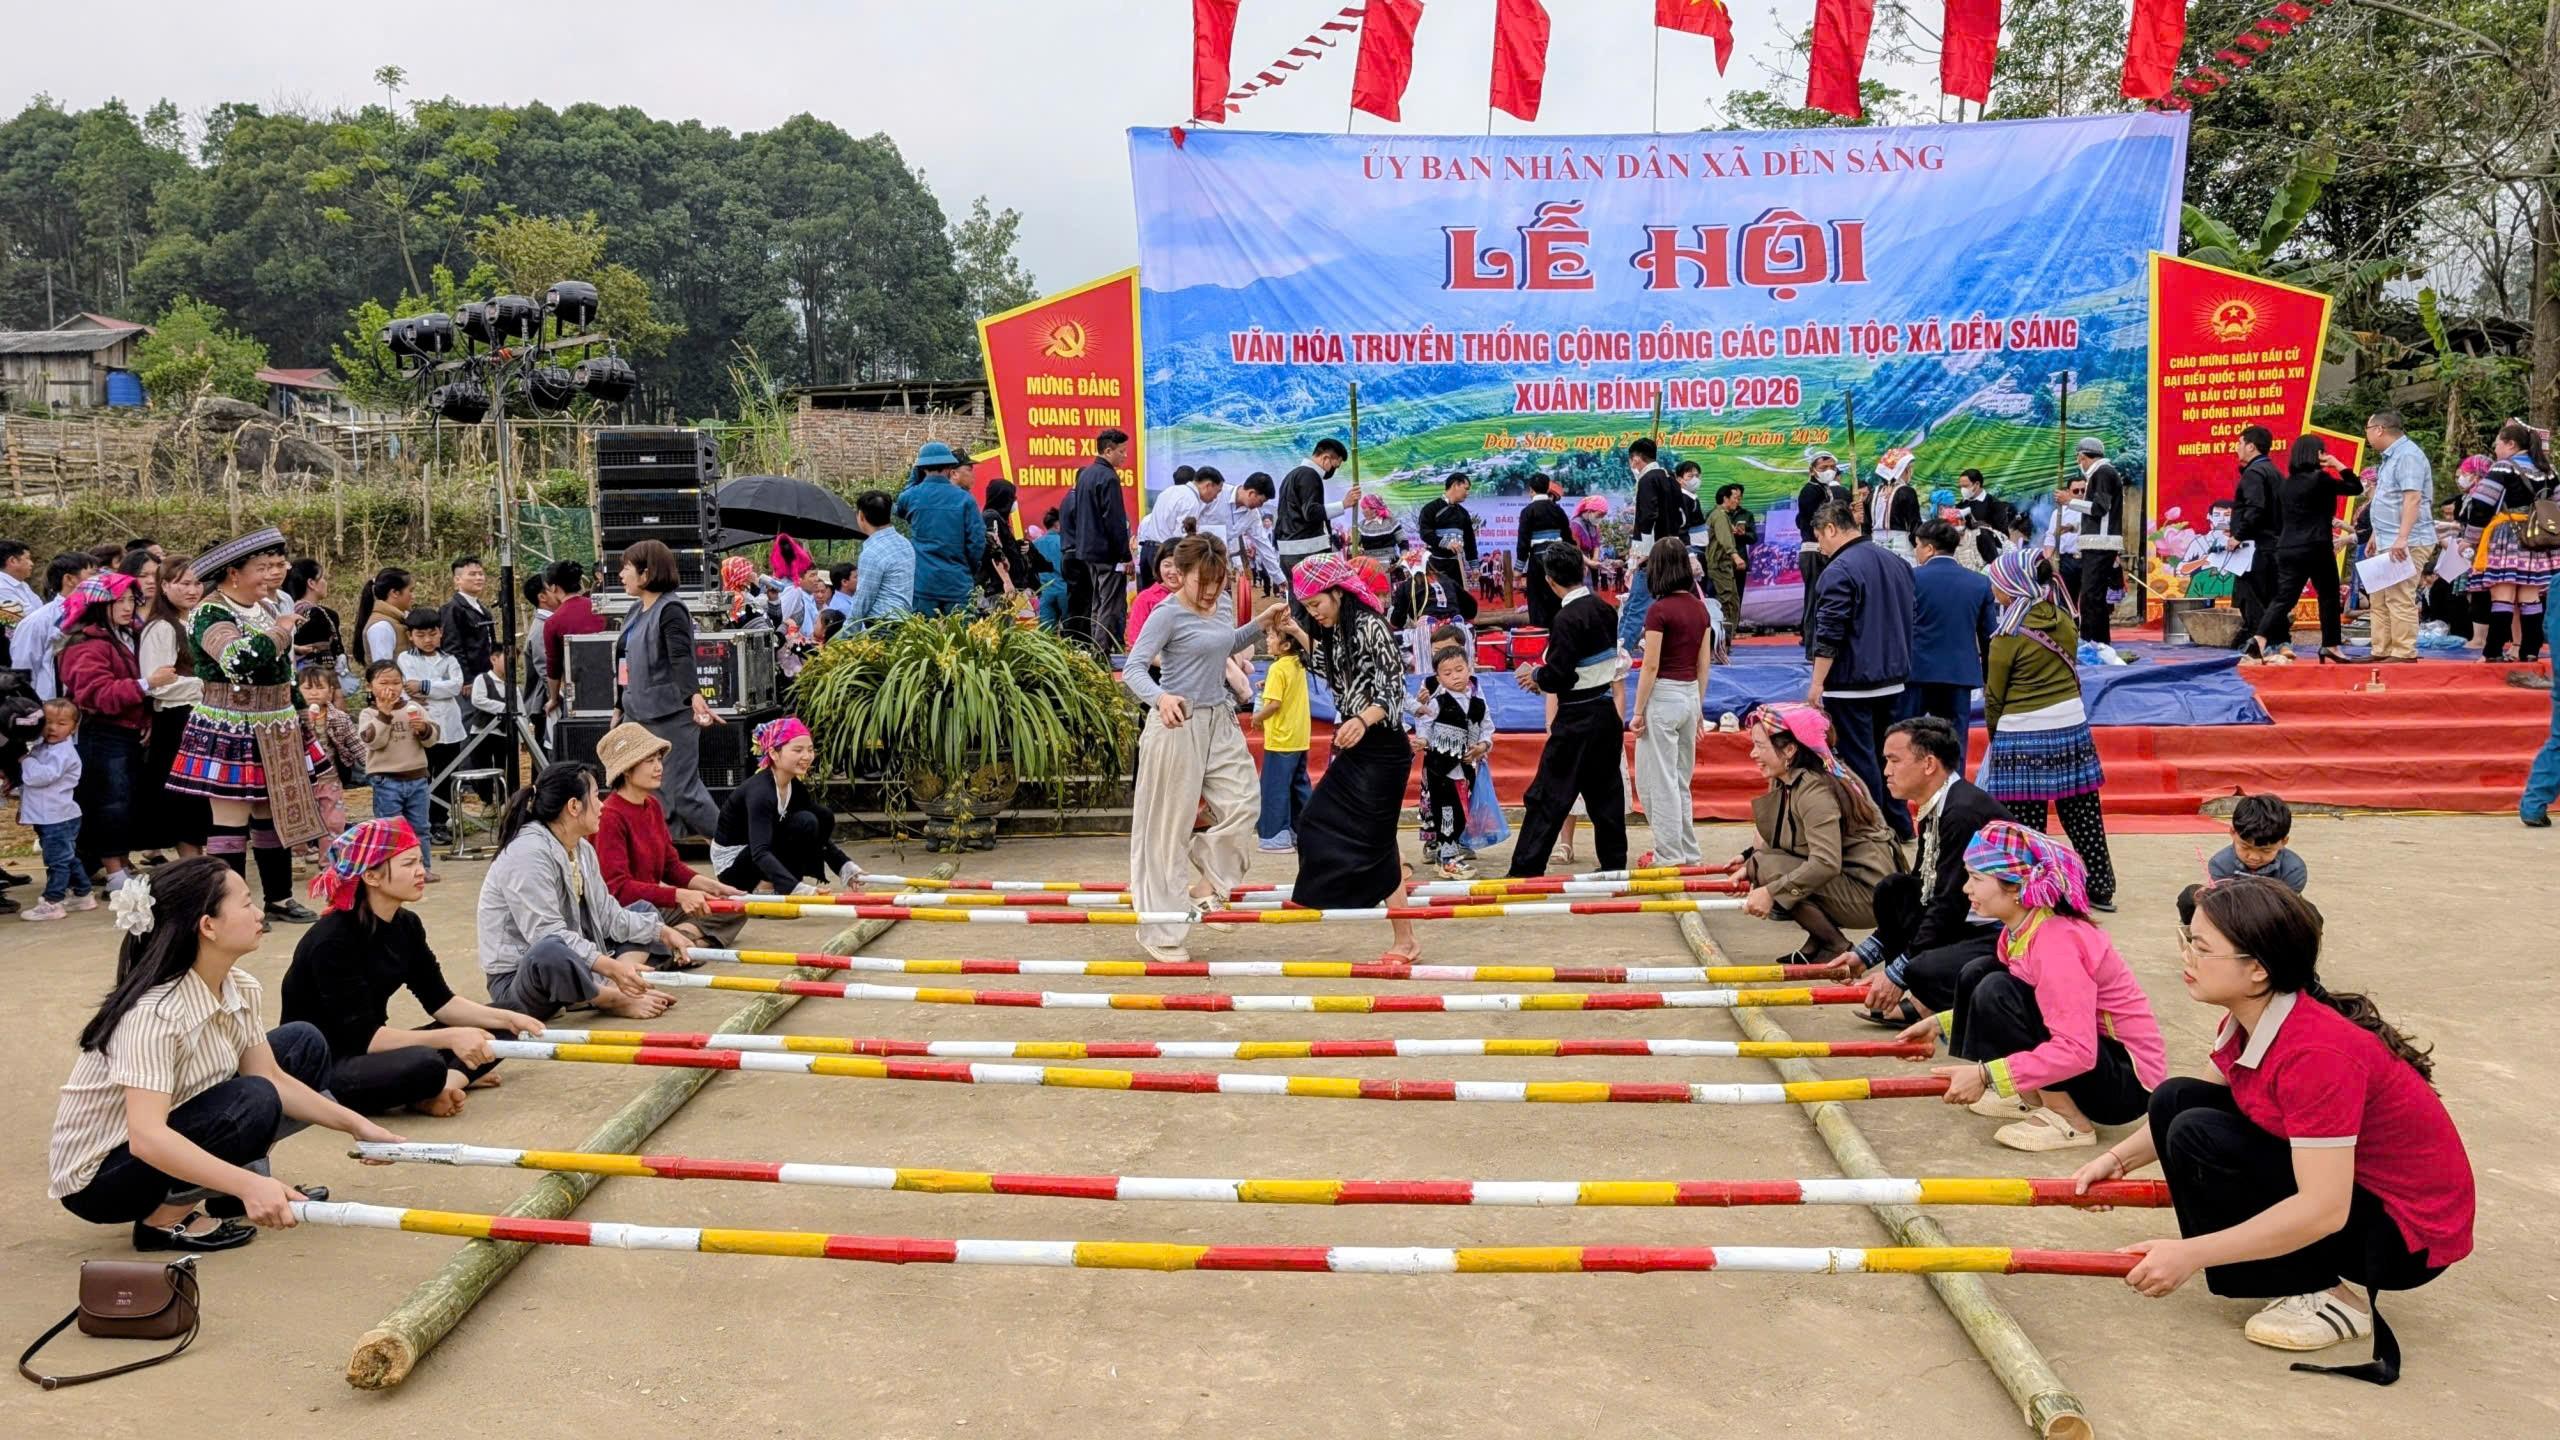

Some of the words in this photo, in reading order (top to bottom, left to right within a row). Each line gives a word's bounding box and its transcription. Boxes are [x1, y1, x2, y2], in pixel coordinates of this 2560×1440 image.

[1362, 147, 1410, 180] ỦY
[1421, 155, 1492, 180] BAN
[1504, 147, 1604, 180] NHÂN
[1616, 145, 1689, 179] DÂN
[1702, 145, 1751, 178] XÃ
[1847, 140, 1945, 174] SÁNG
[1441, 199, 1596, 290] LỄ
[1629, 206, 1870, 301] HỘI
[1230, 328, 1284, 363] VĂN
[1291, 329, 1345, 364] HÓA
[1351, 324, 1454, 363] TRUYỀN
[1462, 322, 1549, 362] THỐNG
[1558, 328, 1630, 367] CỘNG
[1638, 323, 1713, 360] ĐỒNG
[1721, 323, 1776, 358] CÁC
[1785, 321, 1840, 356] DÂN
[1848, 320, 1899, 360] TỘC
[1906, 318, 1943, 353] XÃ
[1951, 312, 2003, 351] DỀN
[2010, 314, 2077, 350] SÁNG
[2169, 353, 2196, 369] CHÀO
[2231, 349, 2259, 365] NGÀY
[2288, 366, 2305, 378] XVI
[1026, 373, 1074, 396] MỪNG
[1078, 371, 1121, 397] ĐẢNG
[1515, 377, 1588, 411] XUÂN
[1597, 376, 1661, 410] BÍNH
[1669, 379, 1726, 414] NGỌ
[1734, 377, 1799, 408] 2026
[2184, 387, 2198, 404] VÀ
[1028, 407, 1081, 427] QUANG
[1085, 408, 1121, 427] VINH
[2231, 403, 2260, 419] NHÂN
[2263, 401, 2284, 416] DÂN
[1483, 430, 1516, 449] Dền
[1574, 432, 1615, 451] ngày
[1670, 430, 1718, 450] tháng
[1723, 430, 1745, 446] 02
[1748, 431, 1784, 446] năm
[1790, 428, 1829, 445] 2026
[2211, 422, 2231, 436] CÁC
[1029, 433, 1076, 456] MỪNG
[2178, 440, 2211, 457] NHIỆM
[1018, 464, 1056, 487] BÍNH
